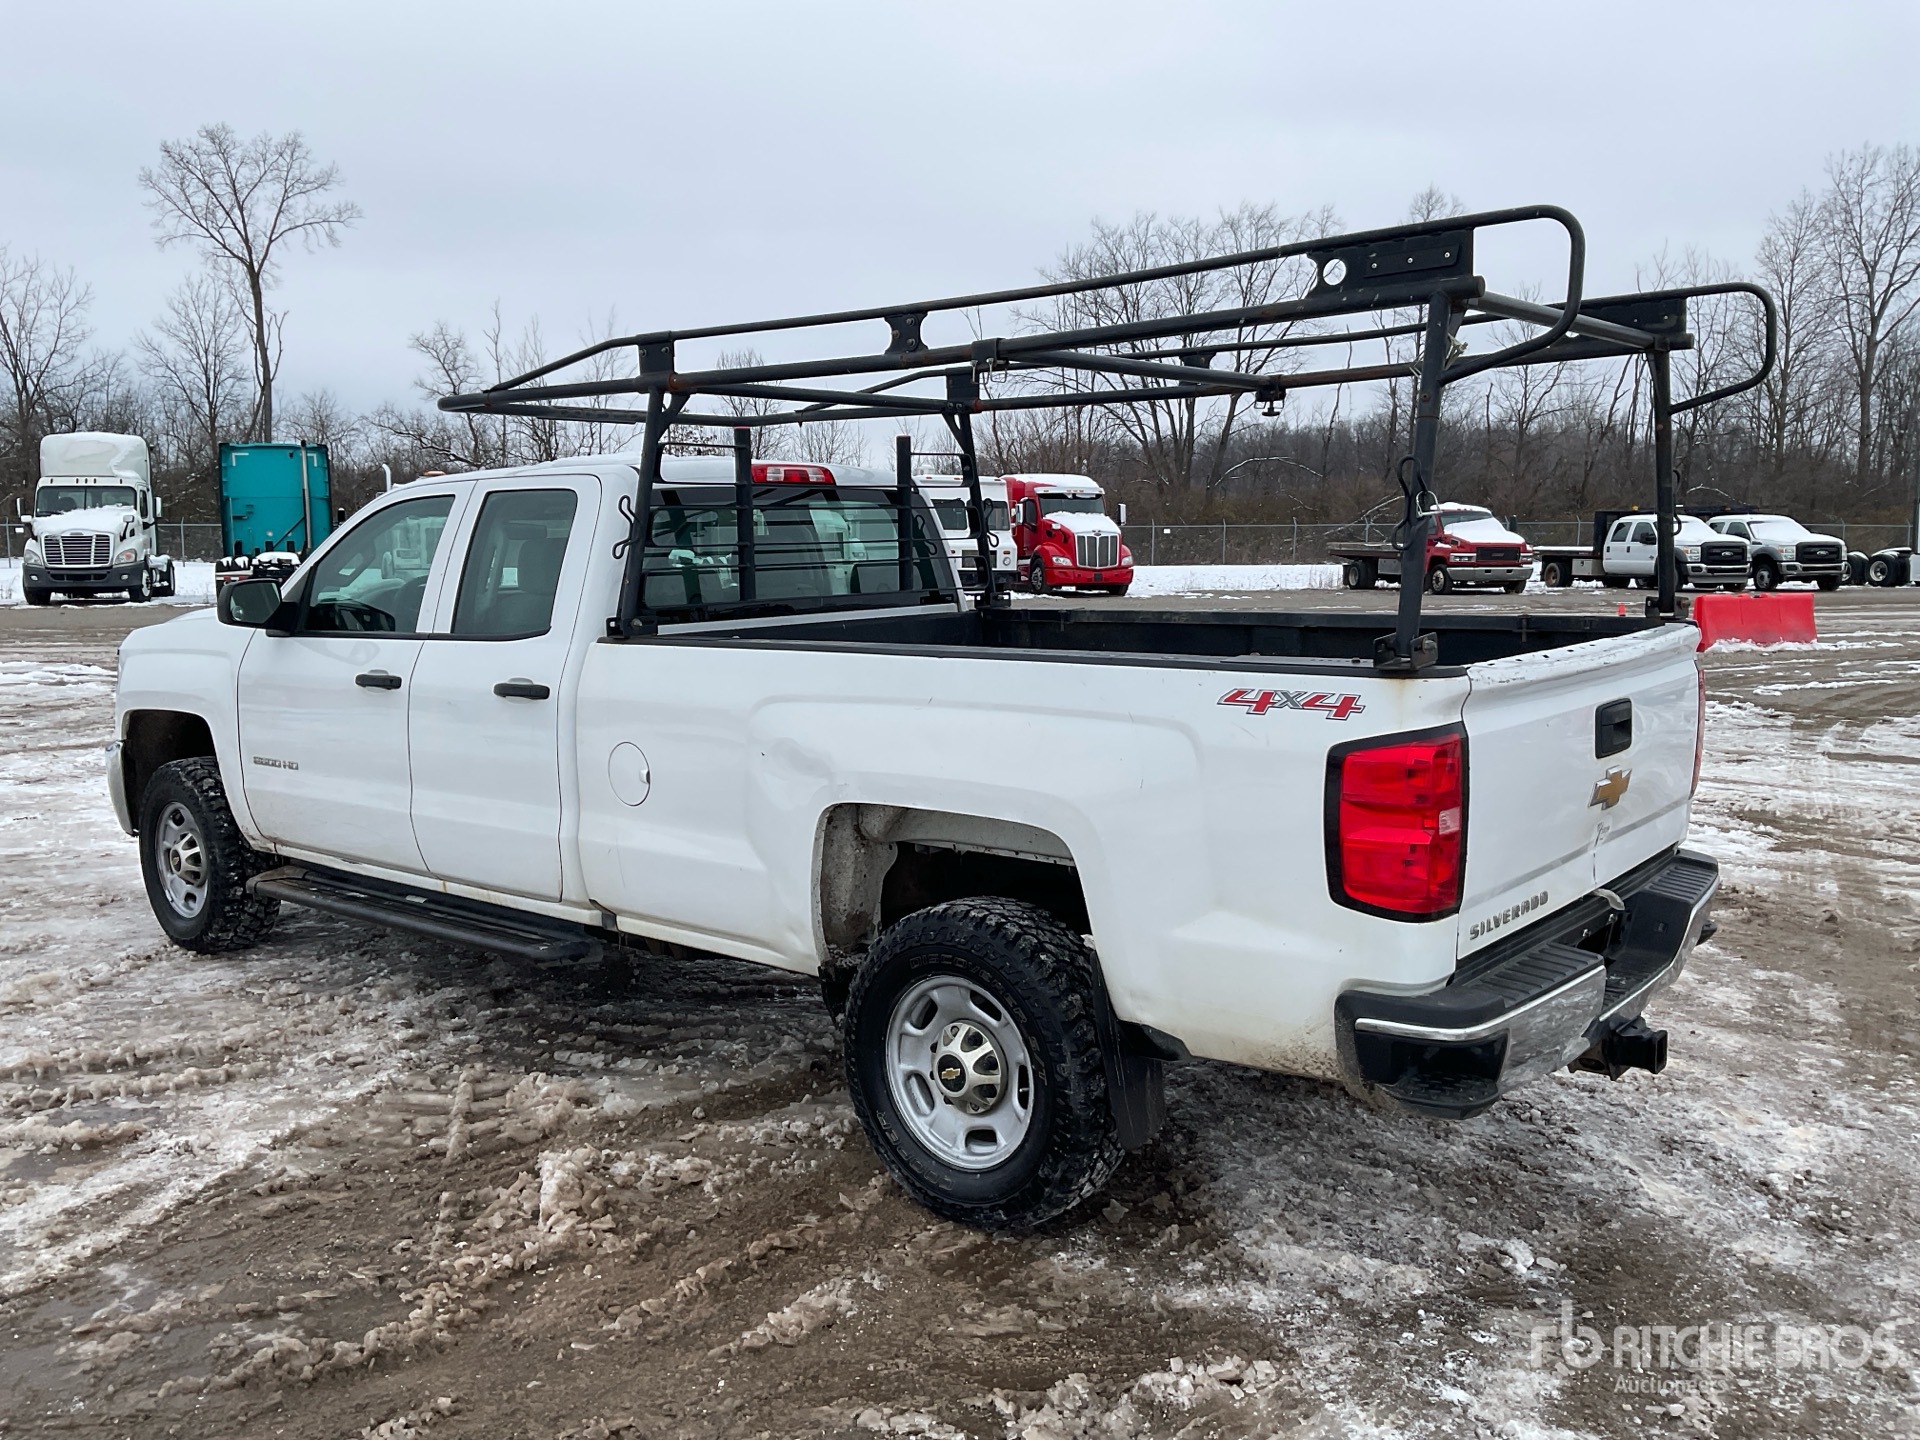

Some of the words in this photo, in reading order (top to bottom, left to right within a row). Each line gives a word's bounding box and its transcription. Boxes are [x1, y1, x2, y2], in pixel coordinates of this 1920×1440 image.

[1469, 890, 1549, 941] SILVERADO
[909, 953, 1028, 1025] DISCOVERER
[1028, 1036, 1049, 1087] S/T
[876, 1110, 954, 1191] COOPER
